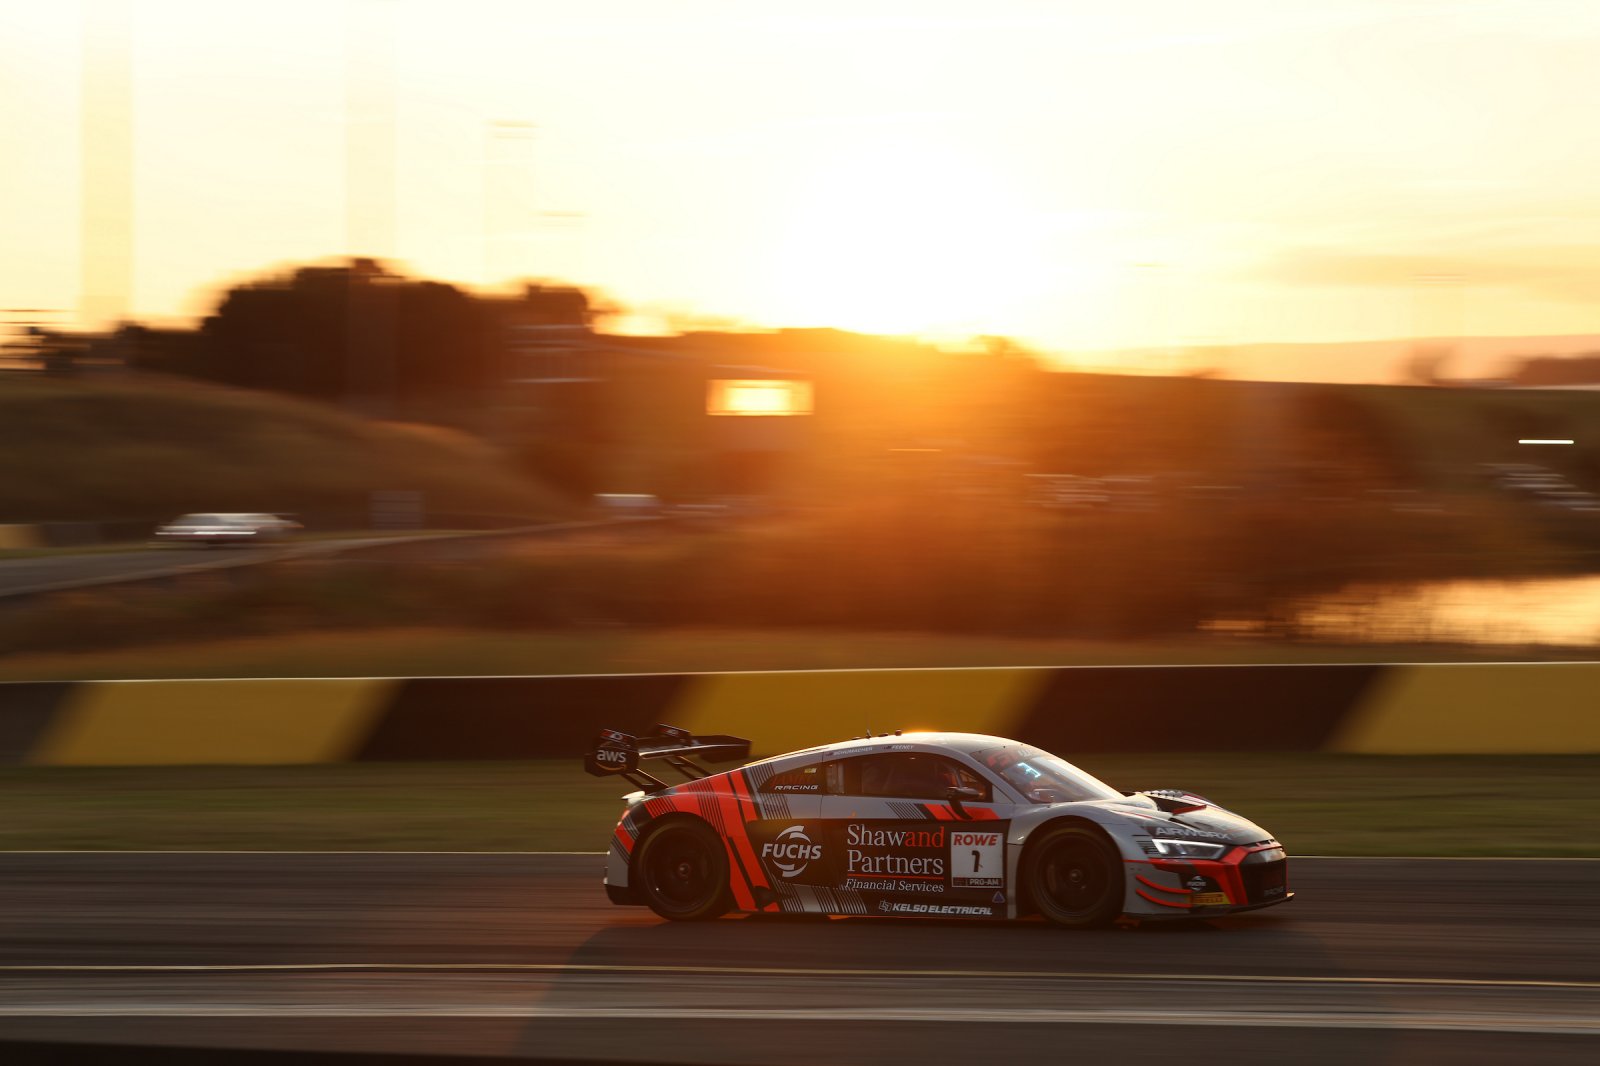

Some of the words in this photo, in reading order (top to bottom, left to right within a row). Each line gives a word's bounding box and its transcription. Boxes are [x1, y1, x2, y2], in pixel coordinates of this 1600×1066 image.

[596, 750, 627, 763] aws
[953, 834, 998, 846] ROWE
[1156, 827, 1233, 840] AIRWORX
[761, 843, 822, 860] FUCHS
[847, 849, 945, 875] Partners
[971, 850, 981, 873] 1
[845, 878, 896, 891] Financial
[898, 880, 945, 893] Services
[969, 878, 999, 886] PRO-AM
[892, 903, 928, 913] KELSO
[927, 904, 993, 915] ELECTRICAL
